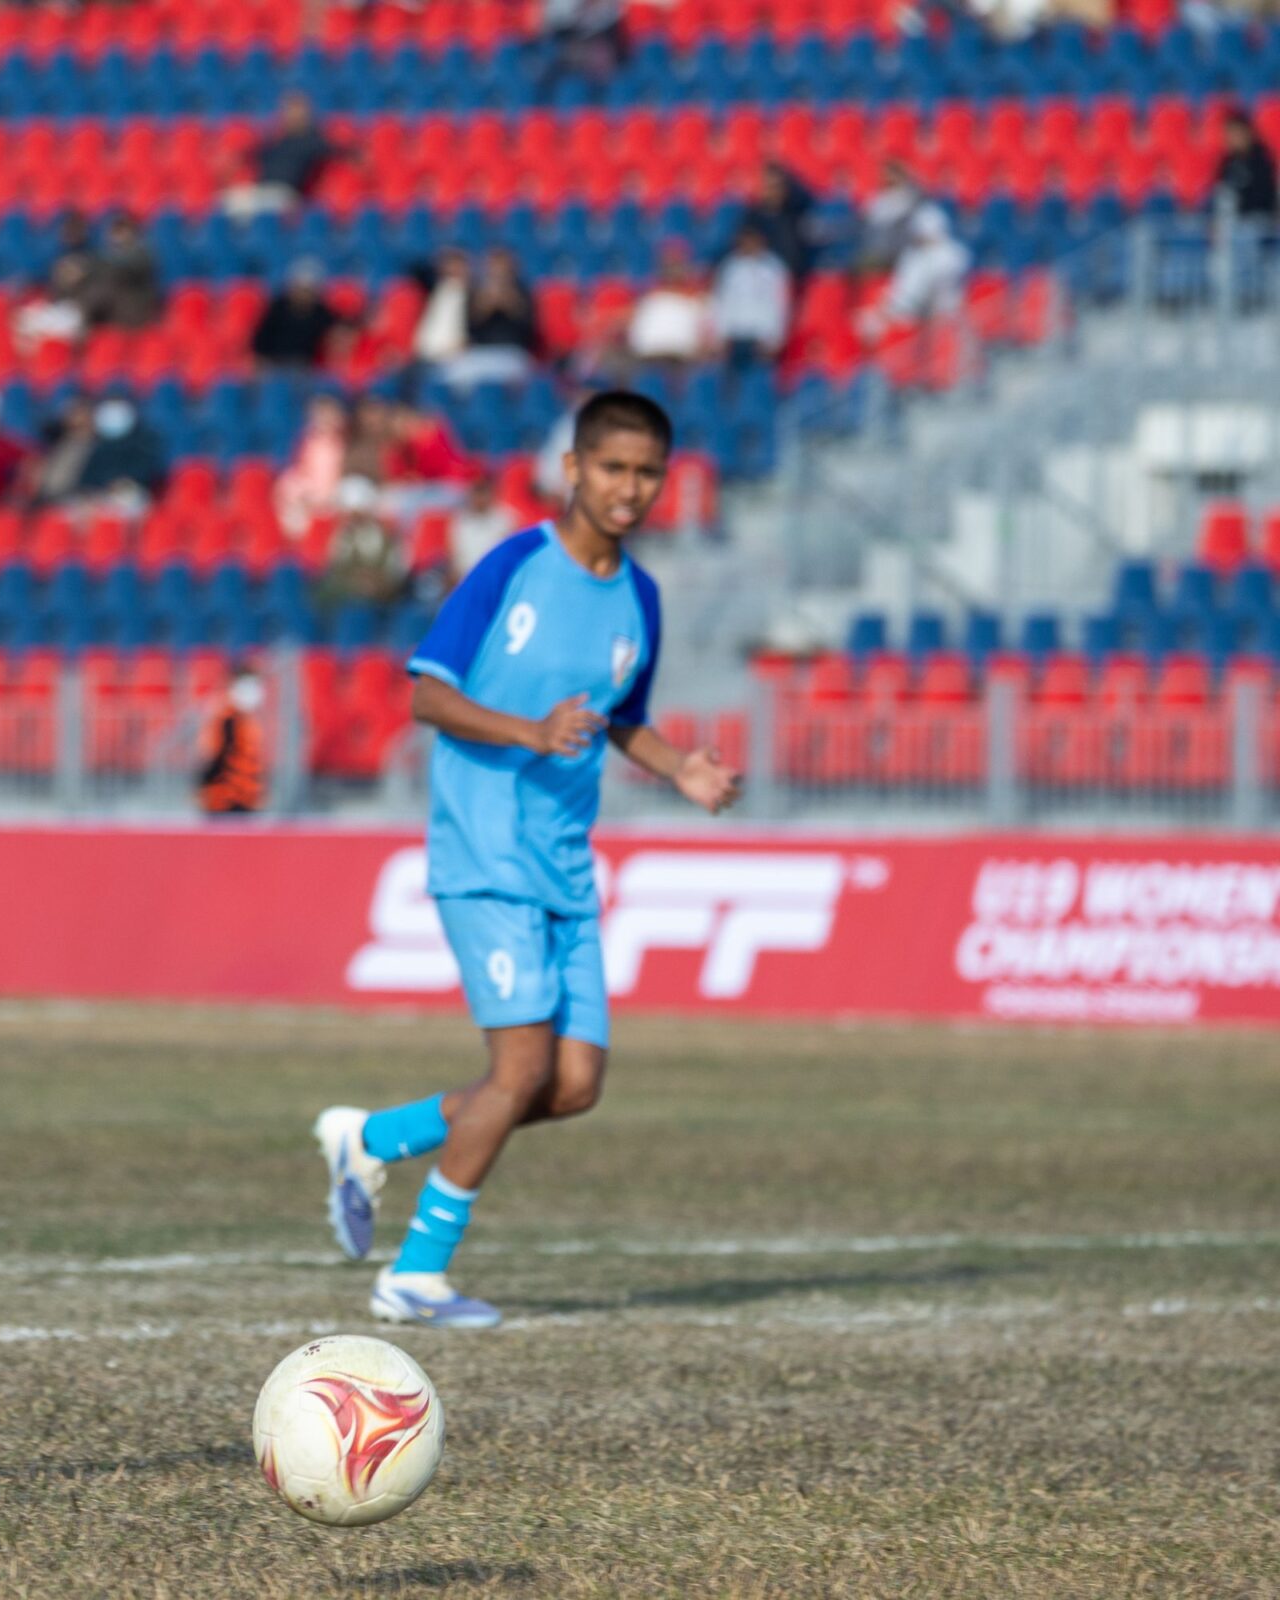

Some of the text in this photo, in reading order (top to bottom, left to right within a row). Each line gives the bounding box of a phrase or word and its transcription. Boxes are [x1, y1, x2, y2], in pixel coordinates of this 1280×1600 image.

[505, 602, 537, 655] 9
[346, 848, 843, 998] SFF
[487, 949, 515, 999] 9
